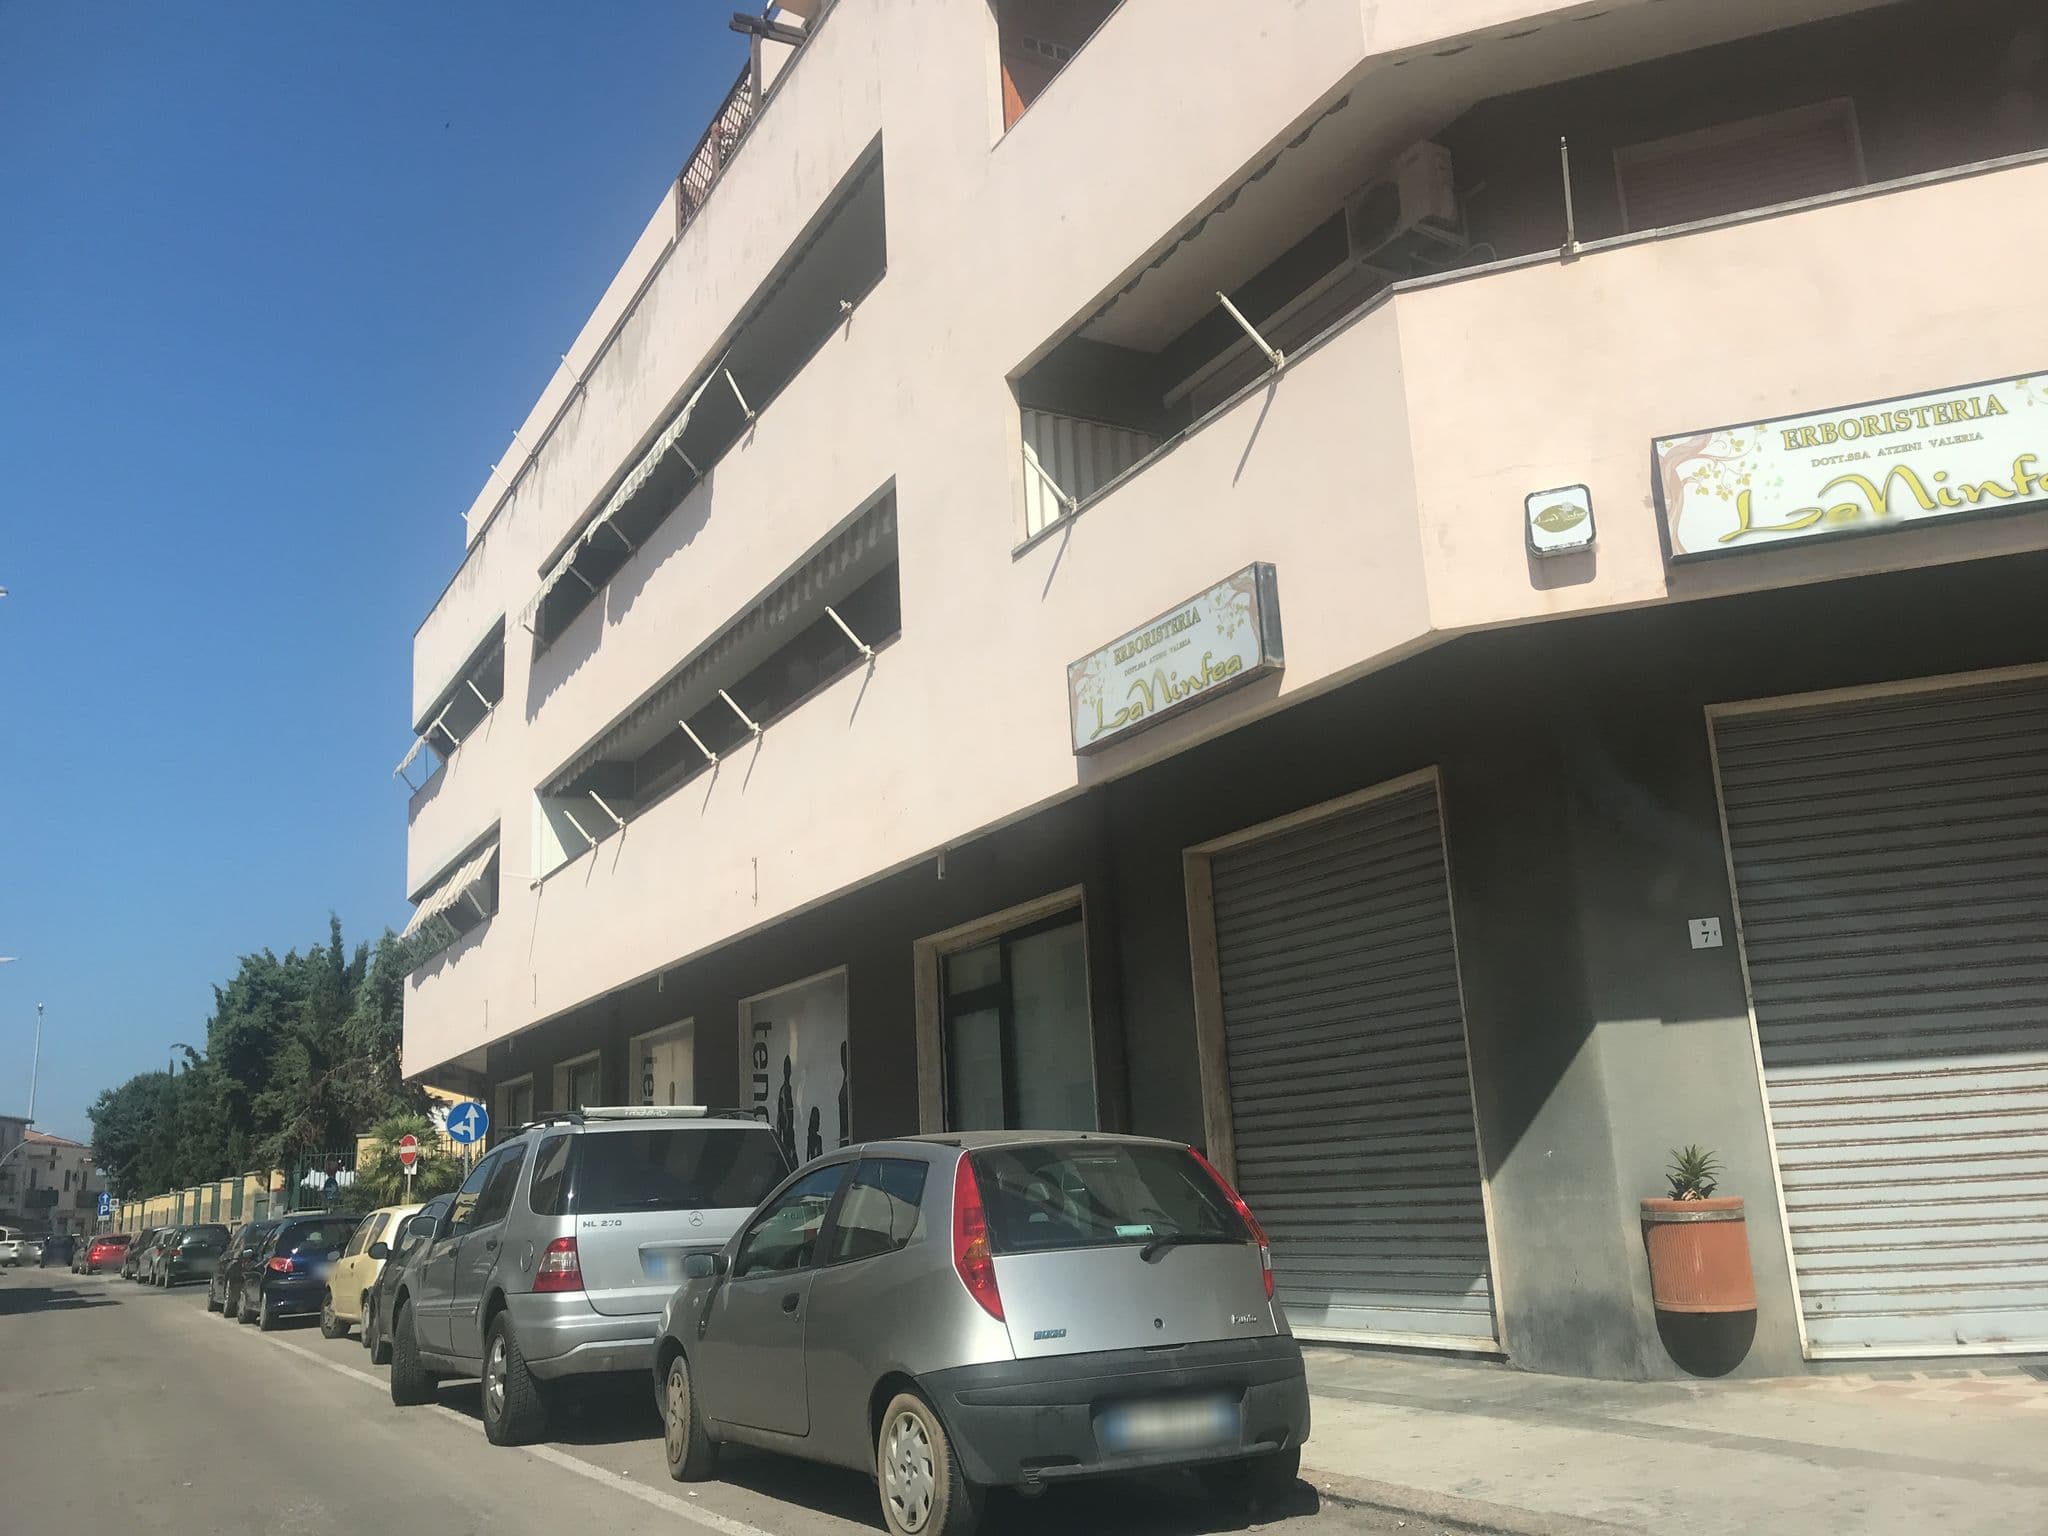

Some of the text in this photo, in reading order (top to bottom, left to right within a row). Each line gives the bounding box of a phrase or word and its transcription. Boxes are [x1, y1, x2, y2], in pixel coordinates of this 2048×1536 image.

[1780, 393, 2009, 452] ERBORISTERIA
[1928, 432, 1984, 448] VALERIA
[1113, 607, 1202, 666] ERBORISTERIA
[1701, 931, 1710, 943] 7
[100, 1205, 108, 1215] P
